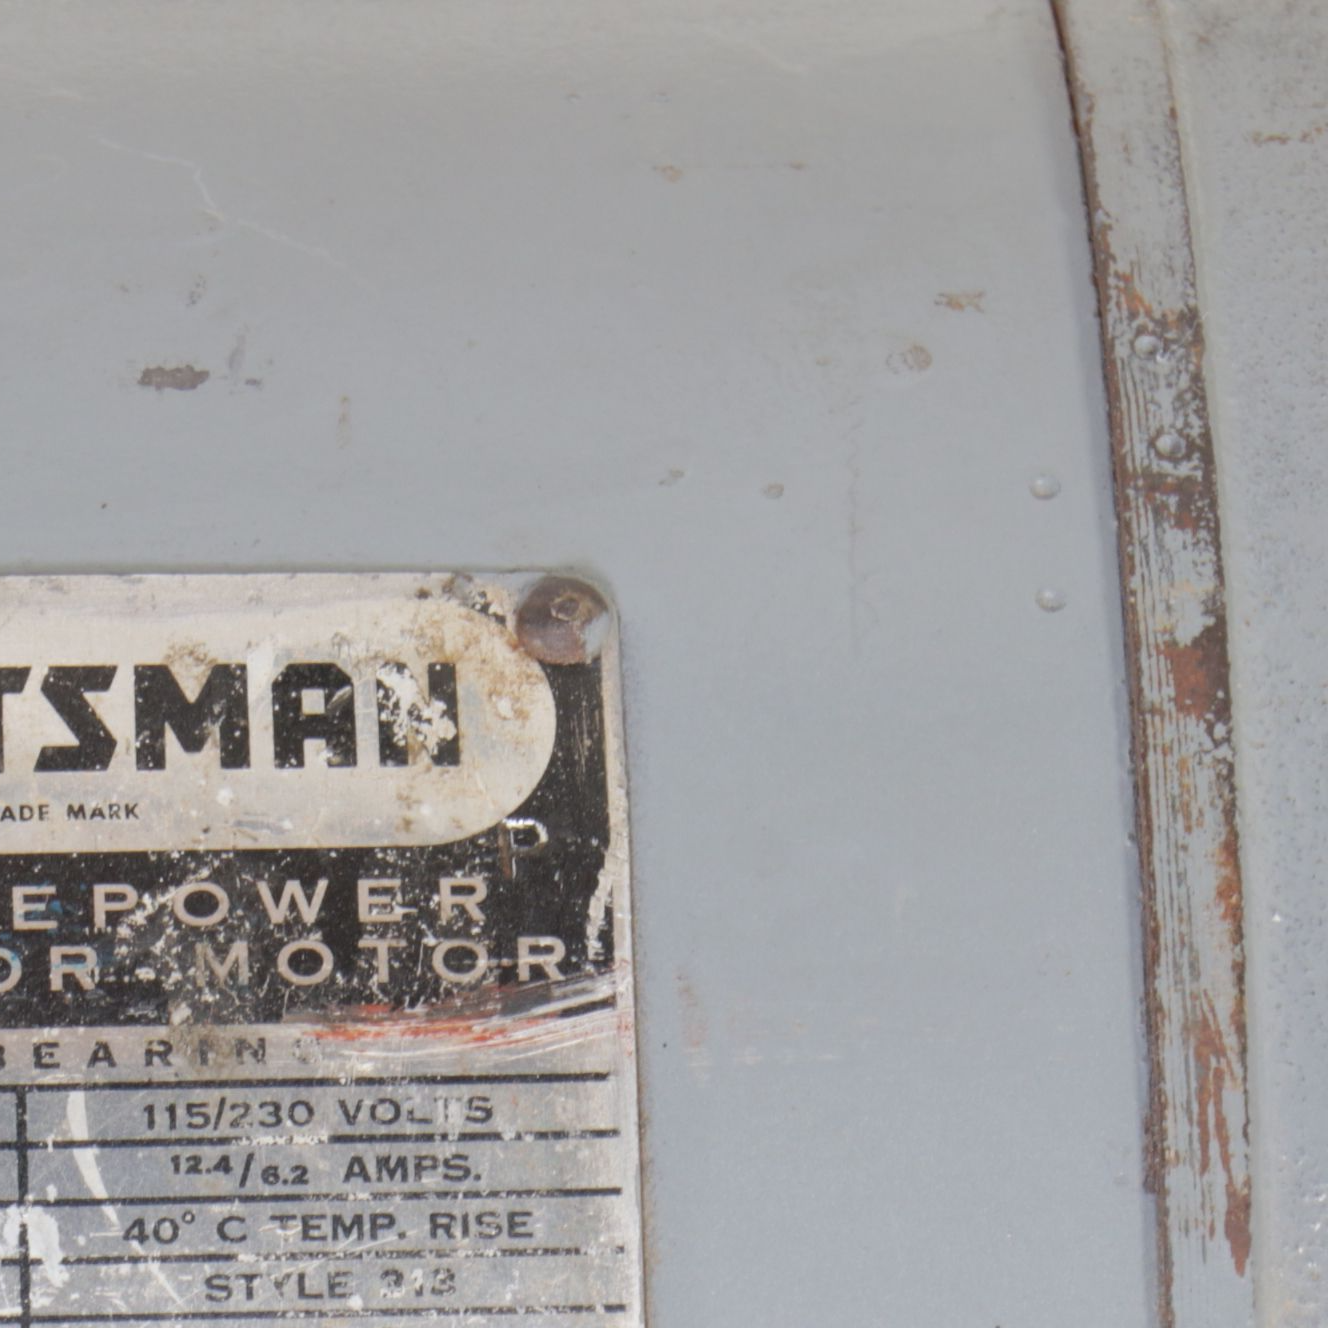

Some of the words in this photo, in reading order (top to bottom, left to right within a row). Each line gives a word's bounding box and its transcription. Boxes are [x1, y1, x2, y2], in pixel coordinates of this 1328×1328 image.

[66, 802, 140, 822] MARK
[198, 936, 566, 987] MOTOR
[143, 1096, 314, 1130] 115/230
[342, 1153, 482, 1184] AMPS.
[217, 1215, 247, 1243] C
[269, 1212, 407, 1242] TEMP.
[429, 1211, 535, 1240] RISE
[204, 1271, 353, 1300] STYLE
